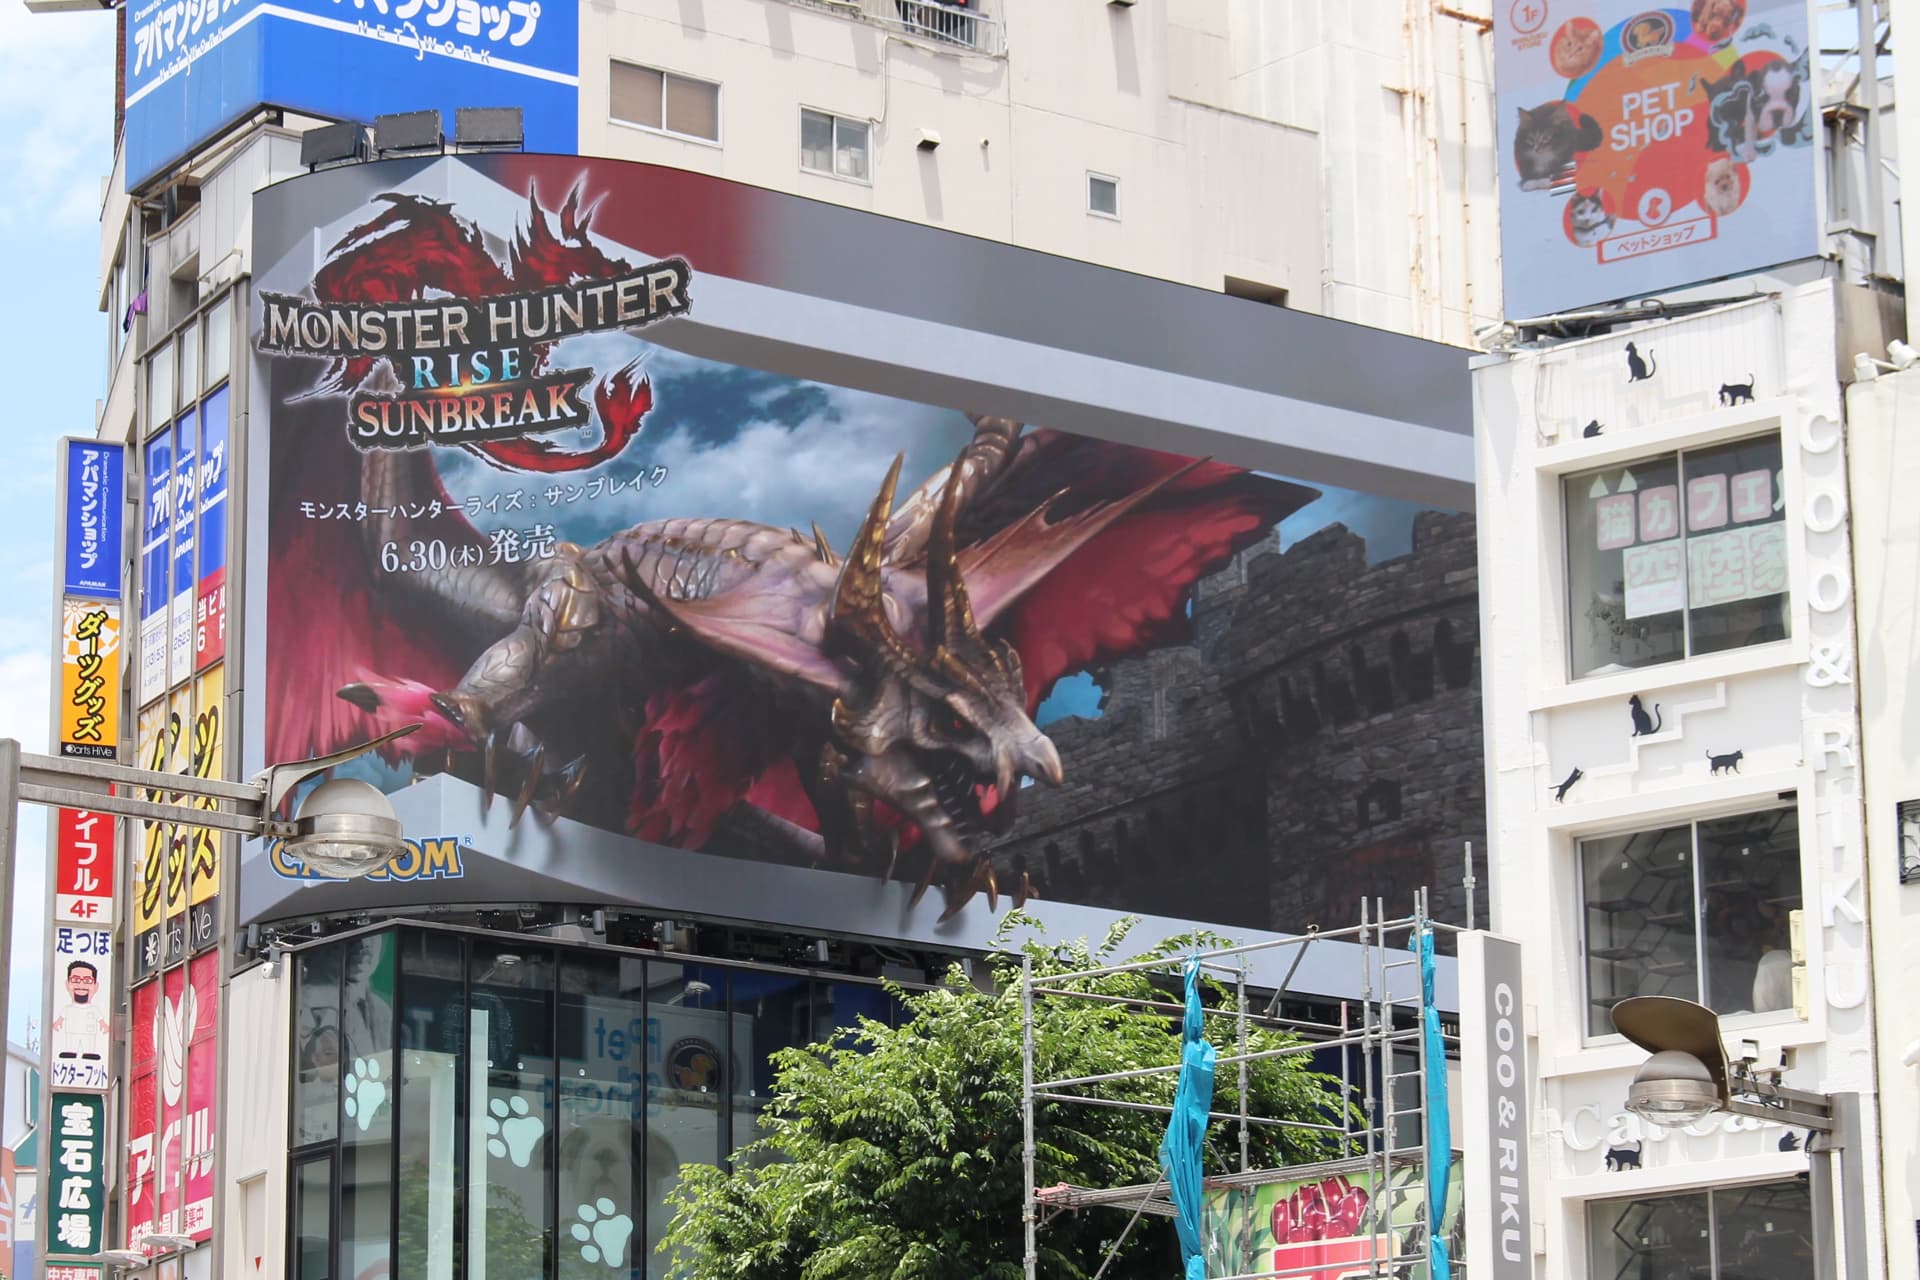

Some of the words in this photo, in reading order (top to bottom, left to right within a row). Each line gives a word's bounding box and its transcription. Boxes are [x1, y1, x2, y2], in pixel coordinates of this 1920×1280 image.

[1622, 82, 1681, 120] PET
[1611, 108, 1694, 151] SHOP
[268, 302, 470, 352] MONSTER
[488, 267, 682, 344] HUNTER
[411, 347, 522, 390] RISE
[356, 383, 578, 438] SUNBREAK
[80, 450, 99, 569] アパマンショップ
[72, 611, 109, 741] ダーツグッズ
[73, 810, 99, 892] イフル
[270, 836, 466, 882] COM
[69, 899, 98, 919] 4F
[56, 928, 111, 957] 足つぼ
[1493, 982, 1517, 1088] COO
[52, 1062, 108, 1088] ドクターフット
[1497, 1099, 1517, 1129] &
[57, 1102, 94, 1249] 宝石広場
[1498, 1138, 1522, 1264] RIKU
